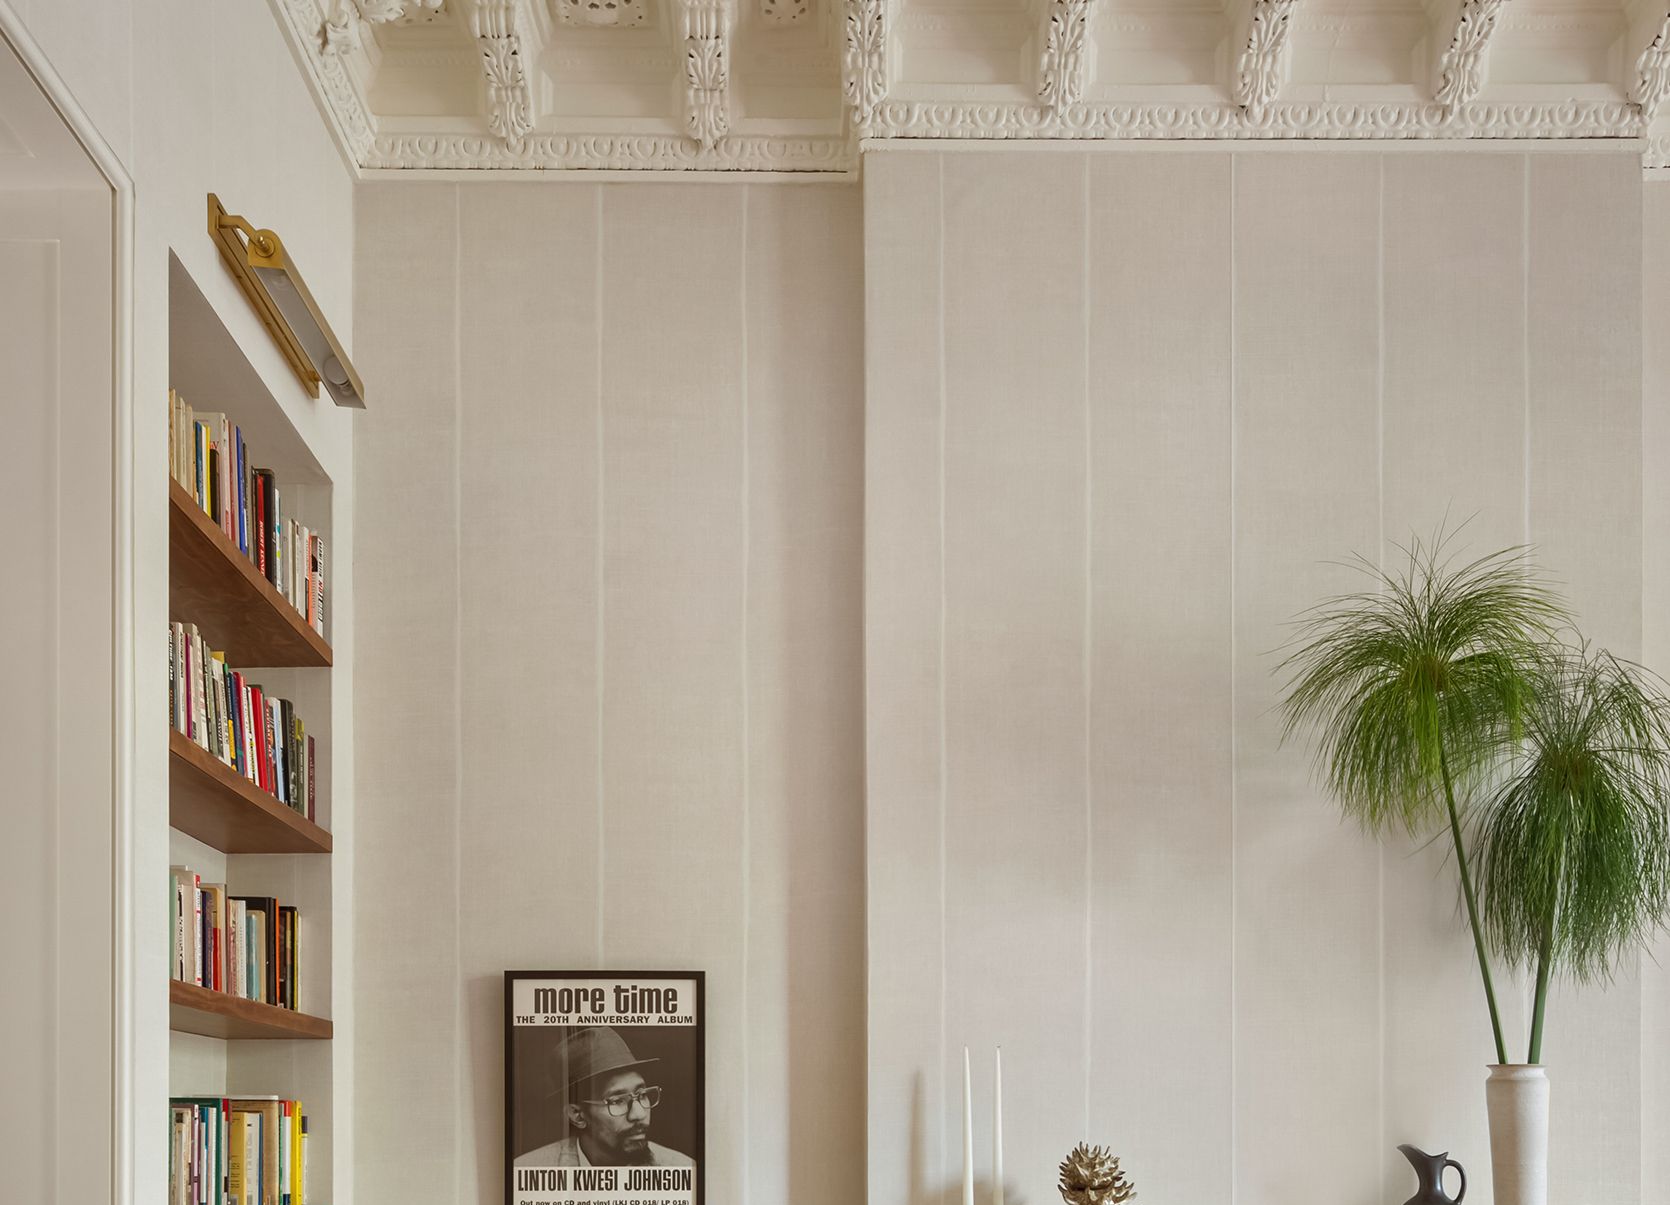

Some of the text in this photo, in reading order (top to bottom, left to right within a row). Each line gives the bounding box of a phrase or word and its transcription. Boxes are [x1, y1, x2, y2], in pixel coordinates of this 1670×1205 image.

[534, 985, 678, 1014] more time
[516, 1016, 693, 1024] THE 20TH ANNIVERSARY ALBUM
[518, 1170, 691, 1191] LINTON KWESI JOHNSON
